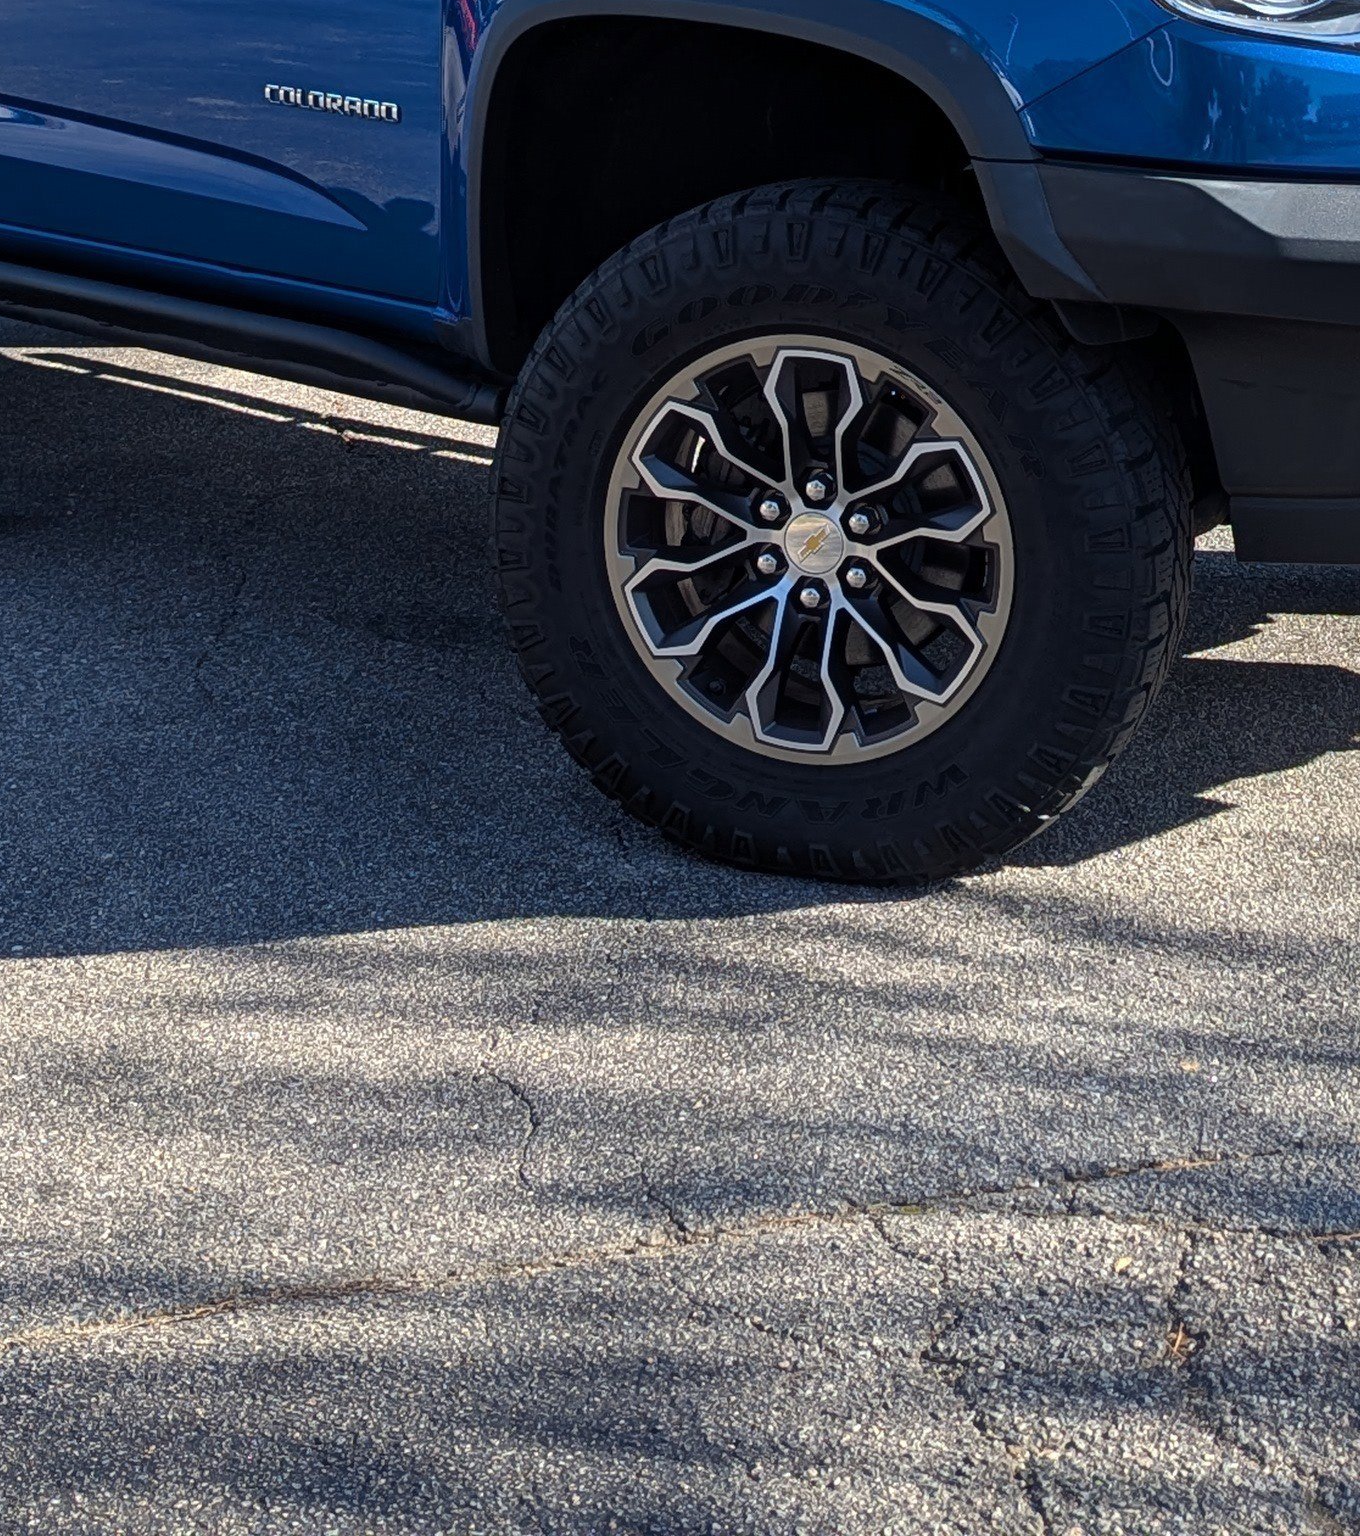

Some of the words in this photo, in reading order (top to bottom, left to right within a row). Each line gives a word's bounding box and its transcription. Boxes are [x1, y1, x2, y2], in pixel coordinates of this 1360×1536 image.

[264, 84, 399, 123] COLORADO
[631, 282, 1046, 480] GOODYEAR
[568, 634, 971, 825] WRANGLER
